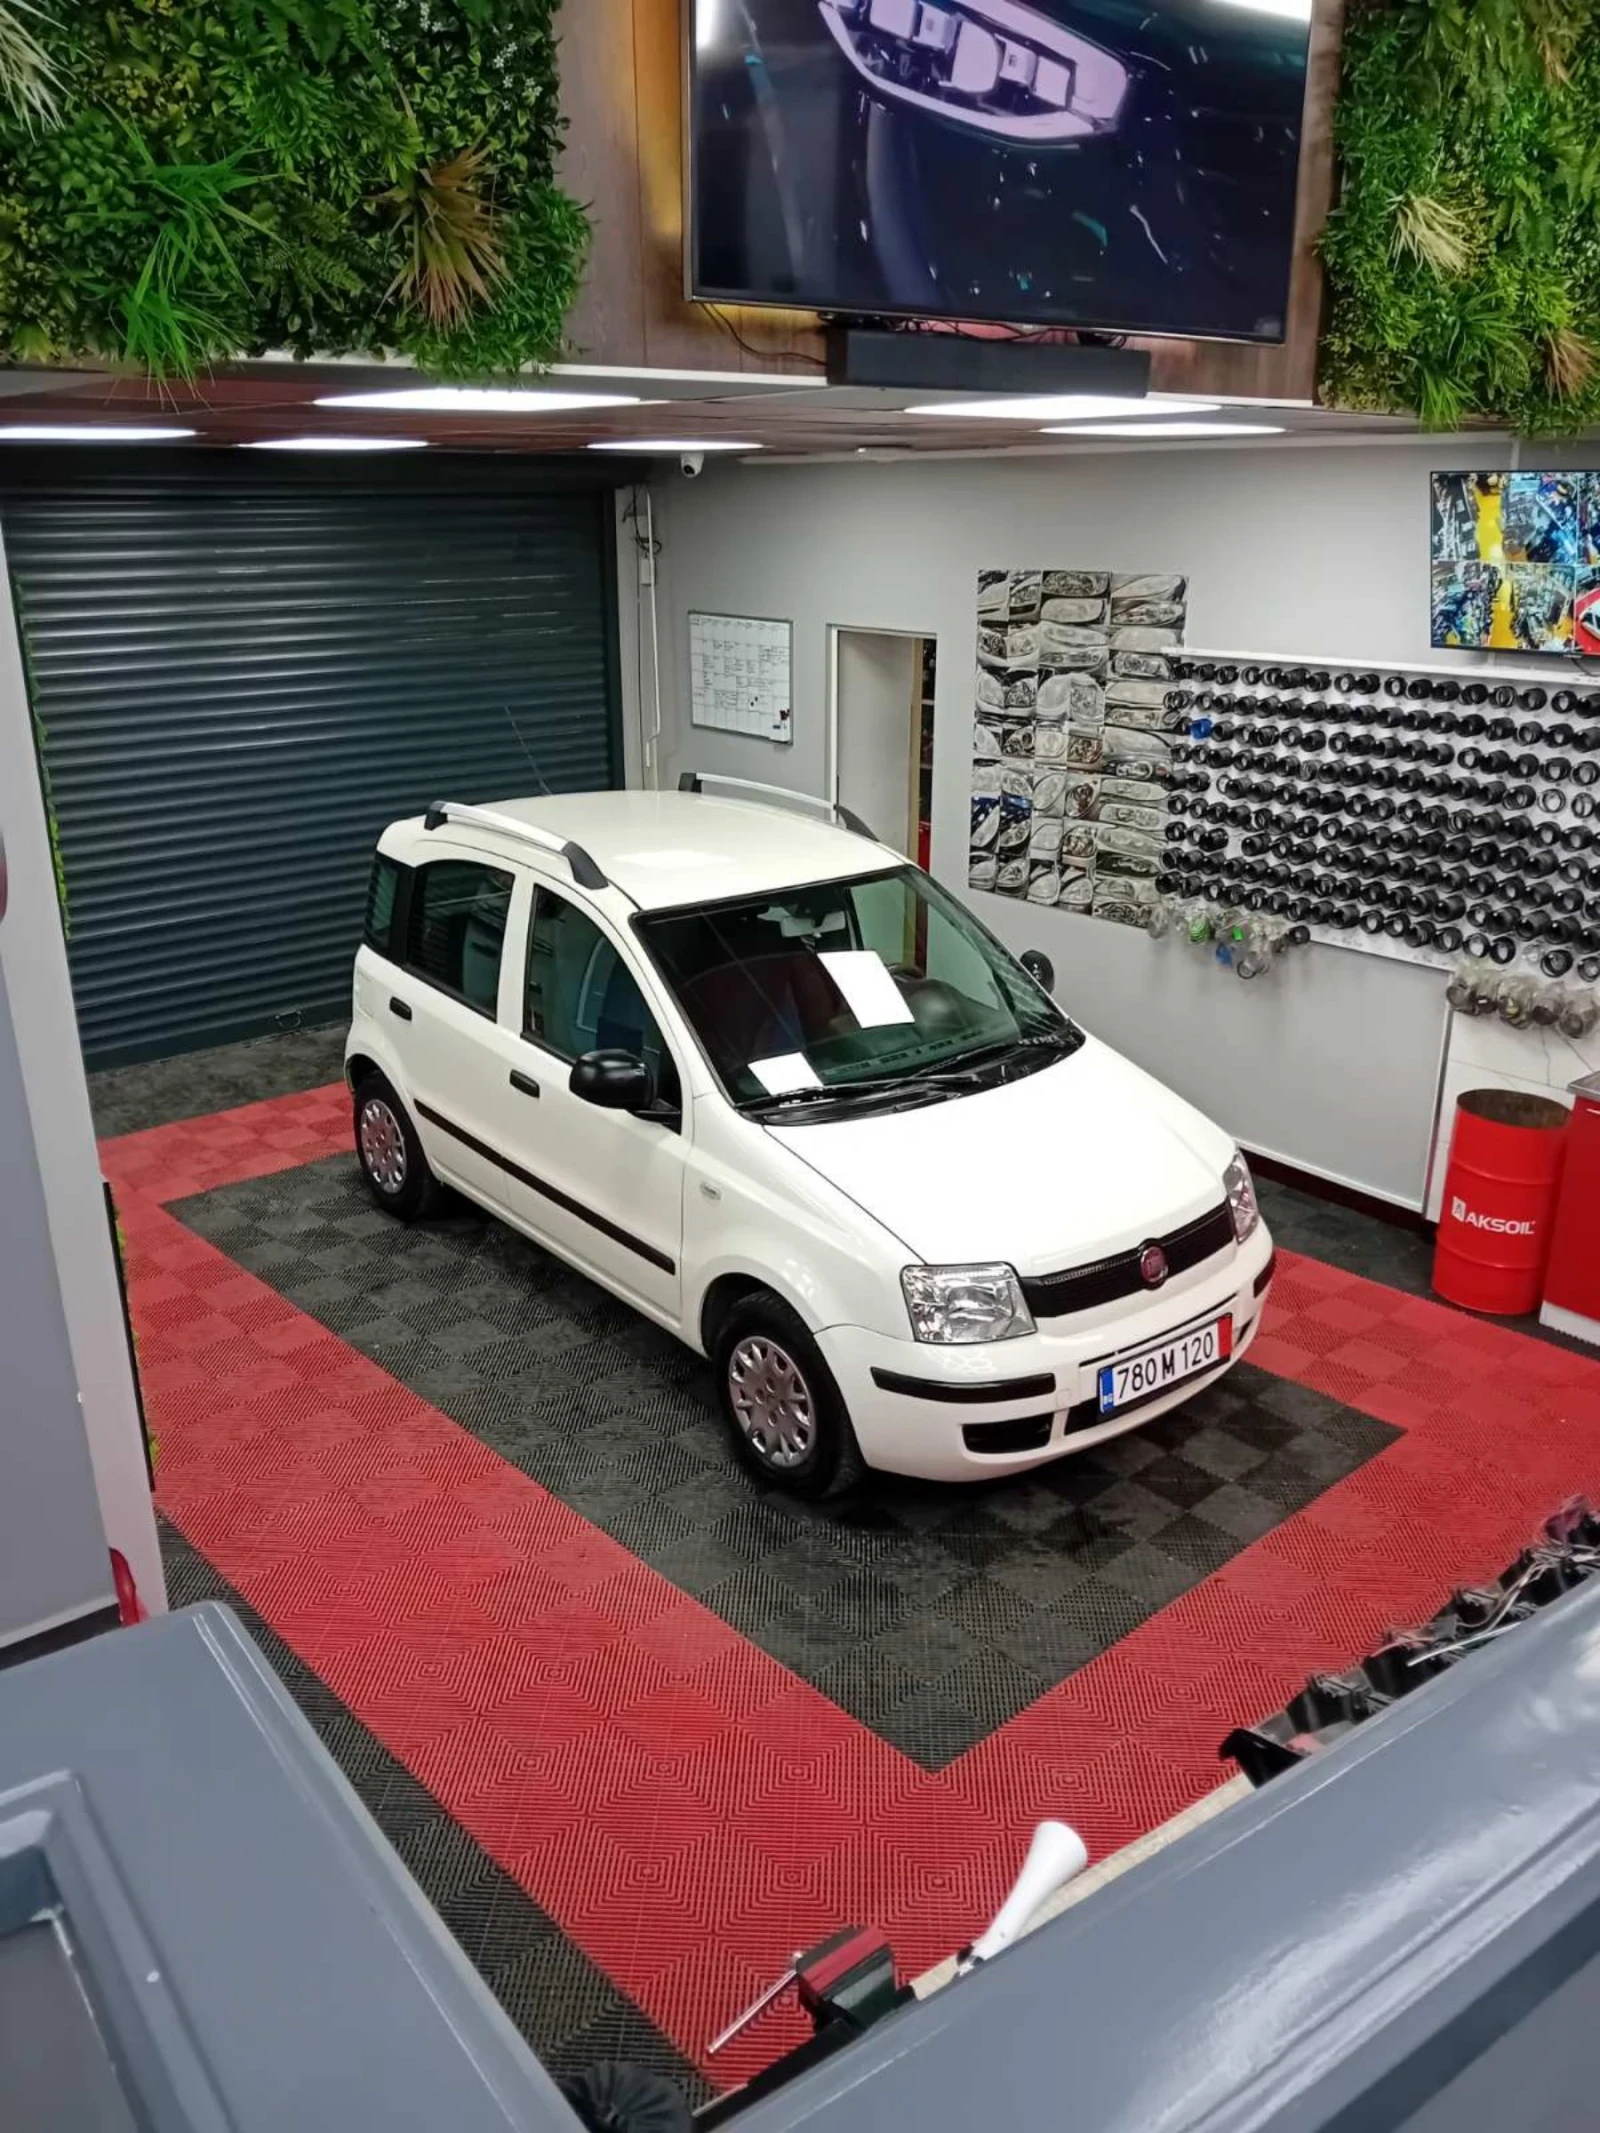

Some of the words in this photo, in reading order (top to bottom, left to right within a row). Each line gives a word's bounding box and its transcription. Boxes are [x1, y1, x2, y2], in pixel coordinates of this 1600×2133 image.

[1465, 1211, 1534, 1235] AKSOIL
[1117, 1358, 1157, 1399] 780
[1181, 1332, 1214, 1370] 120
